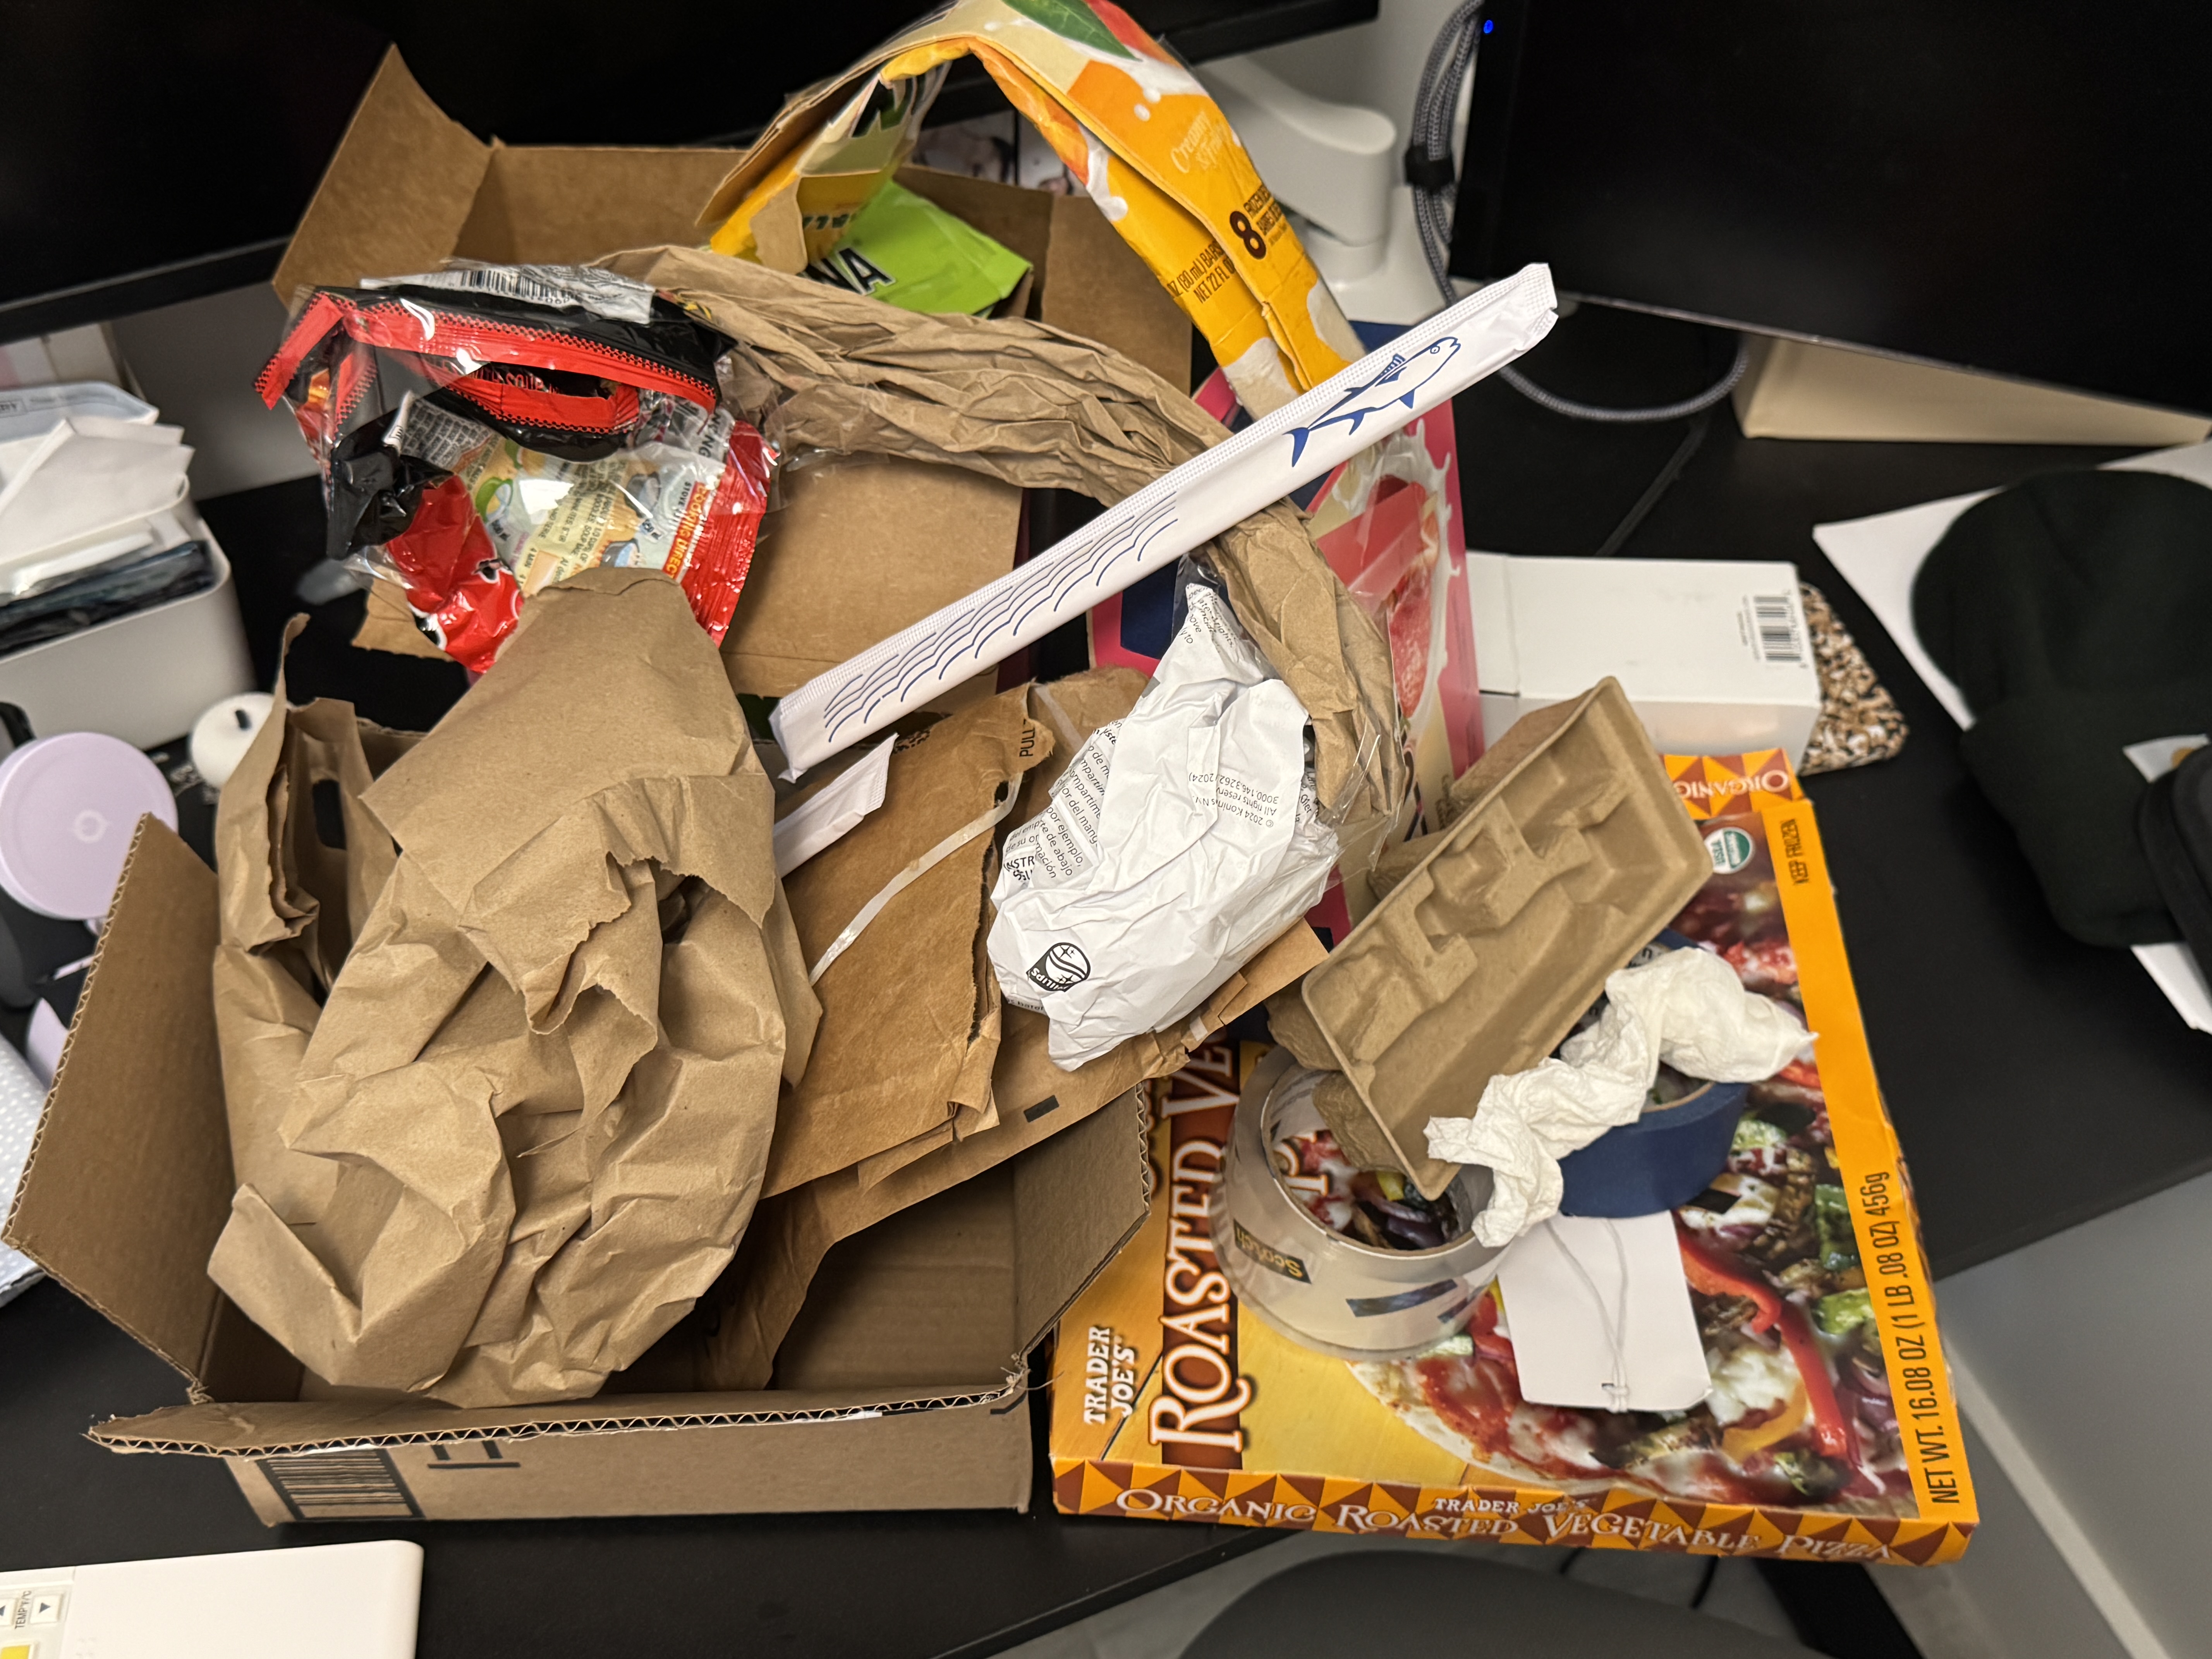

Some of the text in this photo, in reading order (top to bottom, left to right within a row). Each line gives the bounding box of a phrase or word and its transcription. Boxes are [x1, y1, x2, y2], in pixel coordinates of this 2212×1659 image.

[1230, 211, 1266, 260] 8
[1176, 270, 1195, 292] (80
[1193, 281, 1212, 304] NET
[1206, 272, 1222, 292] 22
[1215, 266, 1230, 283] FL
[1184, 634, 1194, 644] to
[1092, 752, 1103, 765] de
[1673, 769, 1789, 799] ORGANIC
[1069, 800, 1085, 816] del
[1243, 796, 1262, 812] rights
[1245, 811, 1263, 825] 2024
[1264, 806, 1277, 816] All
[1046, 833, 1057, 847] de
[1054, 848, 1073, 876] abajo
[1058, 824, 1083, 867] ejemplo,
[1239, 1231, 1303, 1279] Scotch
[1148, 1140, 1253, 1453] ROASTED
[1859, 1171, 1960, 1504] NET WT. 16.08 OZ (1 LB .08 OZ) 456g
[1083, 1326, 1110, 1425] TRADER
[1110, 1346, 1135, 1419] JOE'S
[1116, 1488, 1893, 1560] ORGANIC ROASTED VEGETABLE PIZZA
[1434, 1498, 1590, 1514] TRADER JOE'S
